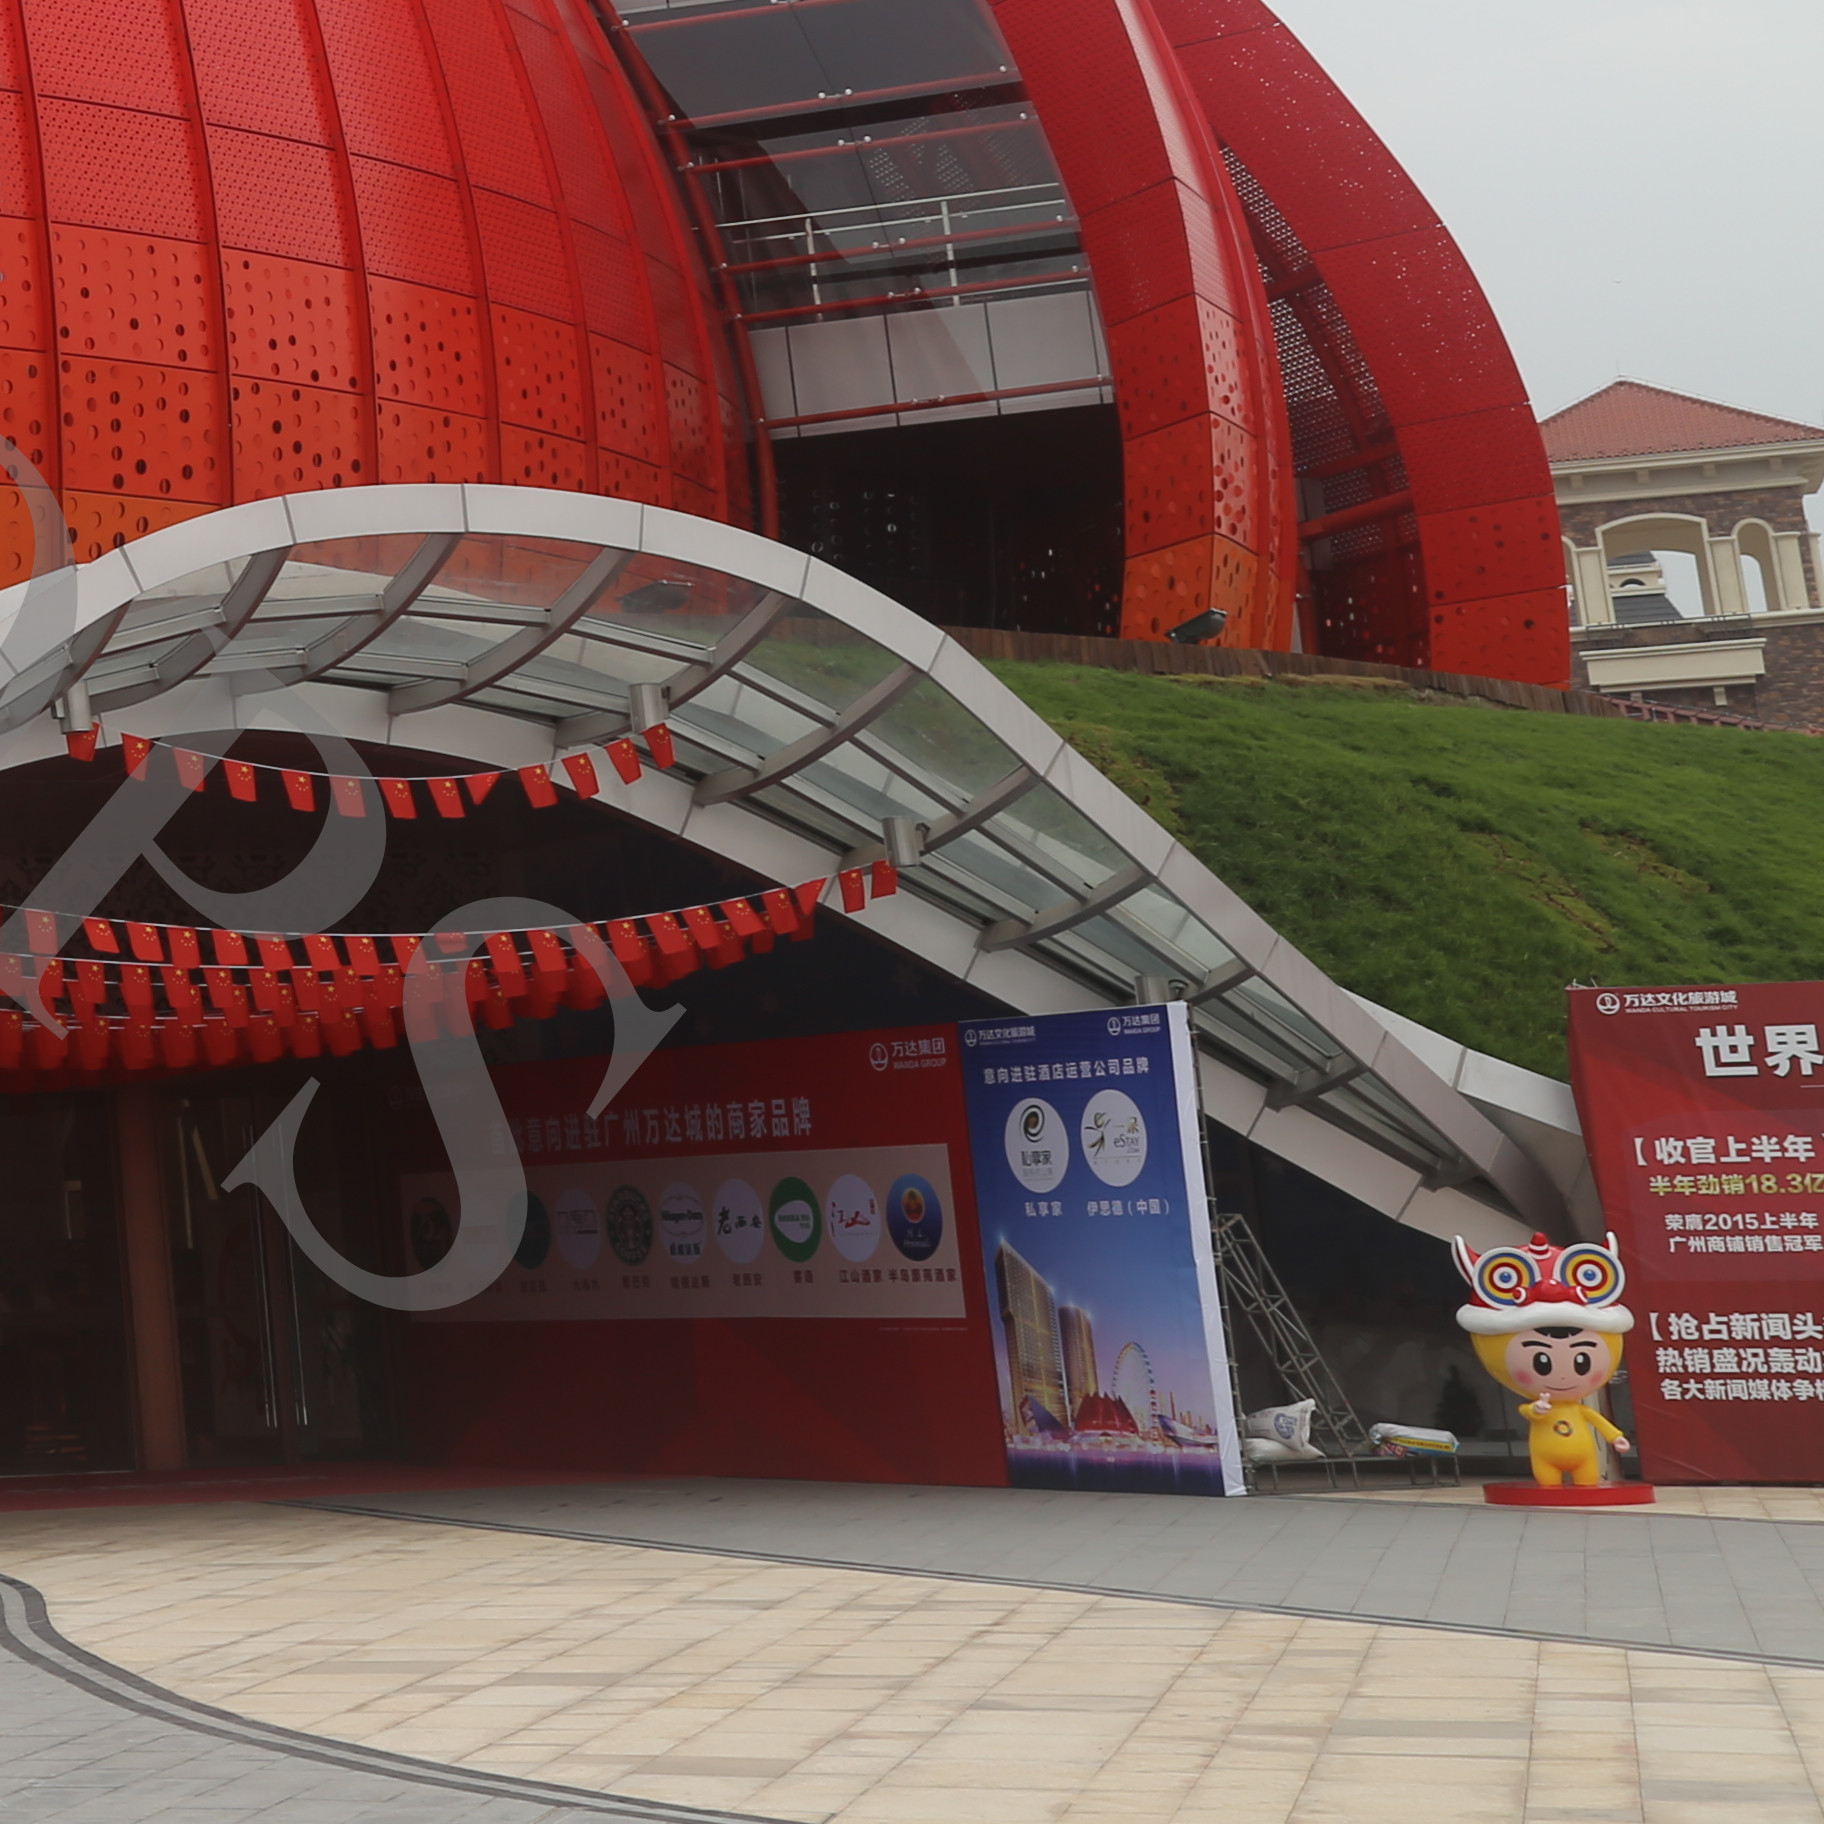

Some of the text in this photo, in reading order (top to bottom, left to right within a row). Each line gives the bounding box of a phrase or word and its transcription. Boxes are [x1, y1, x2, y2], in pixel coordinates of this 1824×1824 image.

[1623, 990, 1738, 1007] 万达文化旅游城
[890, 1037, 946, 1057] 万达集团
[1695, 1024, 1824, 1077] 世界
[984, 1057, 1149, 1084] 意向进驻酒店运营公司品牌
[1634, 1133, 1824, 1166] 【收官上半年
[1649, 1173, 1824, 1196] 半年劲销18.3亿
[1025, 1201, 1063, 1217] 私享家
[1664, 1212, 1819, 1231] 荣膺2015上半年
[1669, 1234, 1824, 1253] 广州商铺销售冠军
[1649, 1312, 1824, 1341] 【抢占新闻头
[1656, 1347, 1824, 1374] 热销盛况轰动
